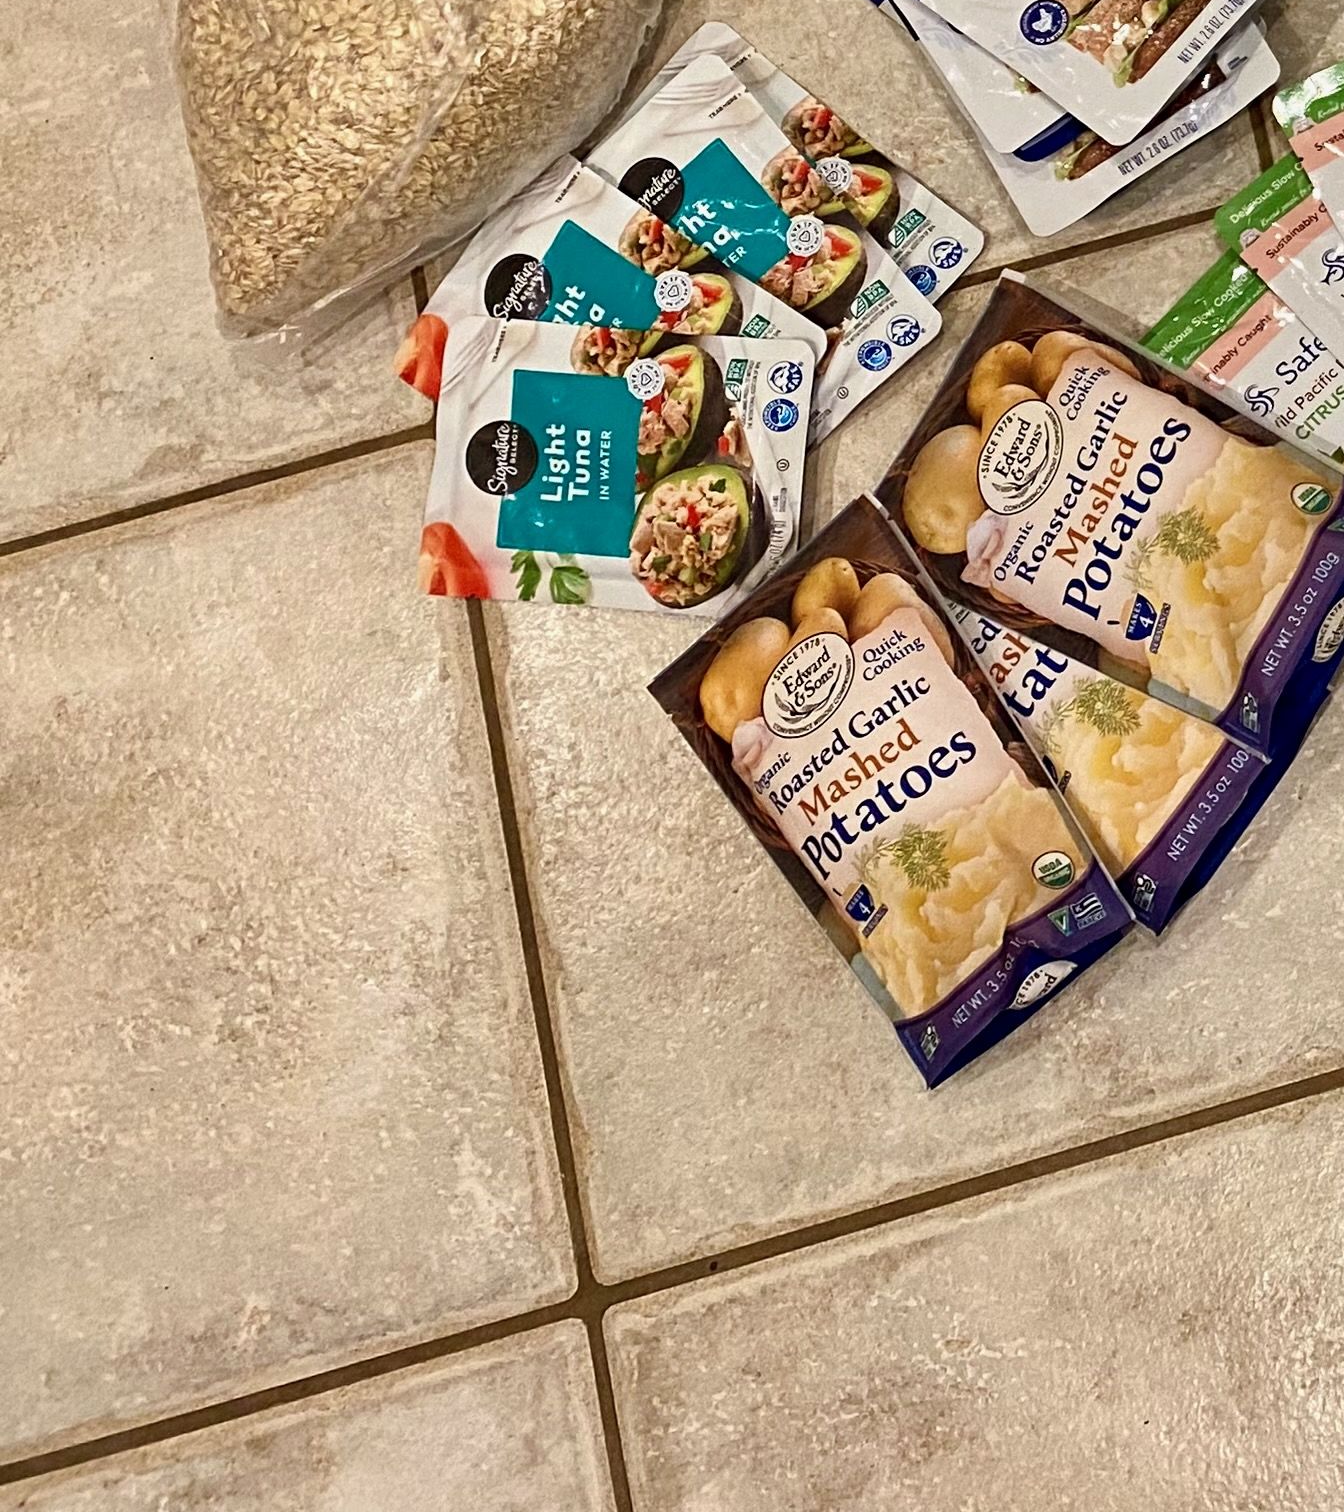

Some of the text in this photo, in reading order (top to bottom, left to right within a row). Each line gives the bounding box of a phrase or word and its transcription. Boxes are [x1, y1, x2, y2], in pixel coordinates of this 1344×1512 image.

[1177, 48, 1193, 63] NET
[1200, 24, 1215, 39] 2.6
[1059, 366, 1089, 408] Quick
[1066, 367, 1110, 421] Cooking
[487, 423, 518, 492] Signature
[540, 424, 570, 501] Light
[568, 430, 590, 501] Tuna
[600, 430, 612, 500] IN WATER
[982, 416, 1013, 472] SINCE 1978
[994, 418, 1031, 478] Edward
[1011, 428, 1042, 481] & Sons
[1014, 391, 1128, 584] Roasted Garlic
[1052, 433, 1139, 568] Mashed
[1062, 418, 1190, 620] Potatoes
[994, 521, 1034, 581] Organic
[1261, 552, 1340, 676] NET WT. 3.5 oz 100g
[769, 677, 930, 815] Roasted Garlic
[798, 718, 922, 826] Mashed
[802, 731, 976, 880] Potatoes
